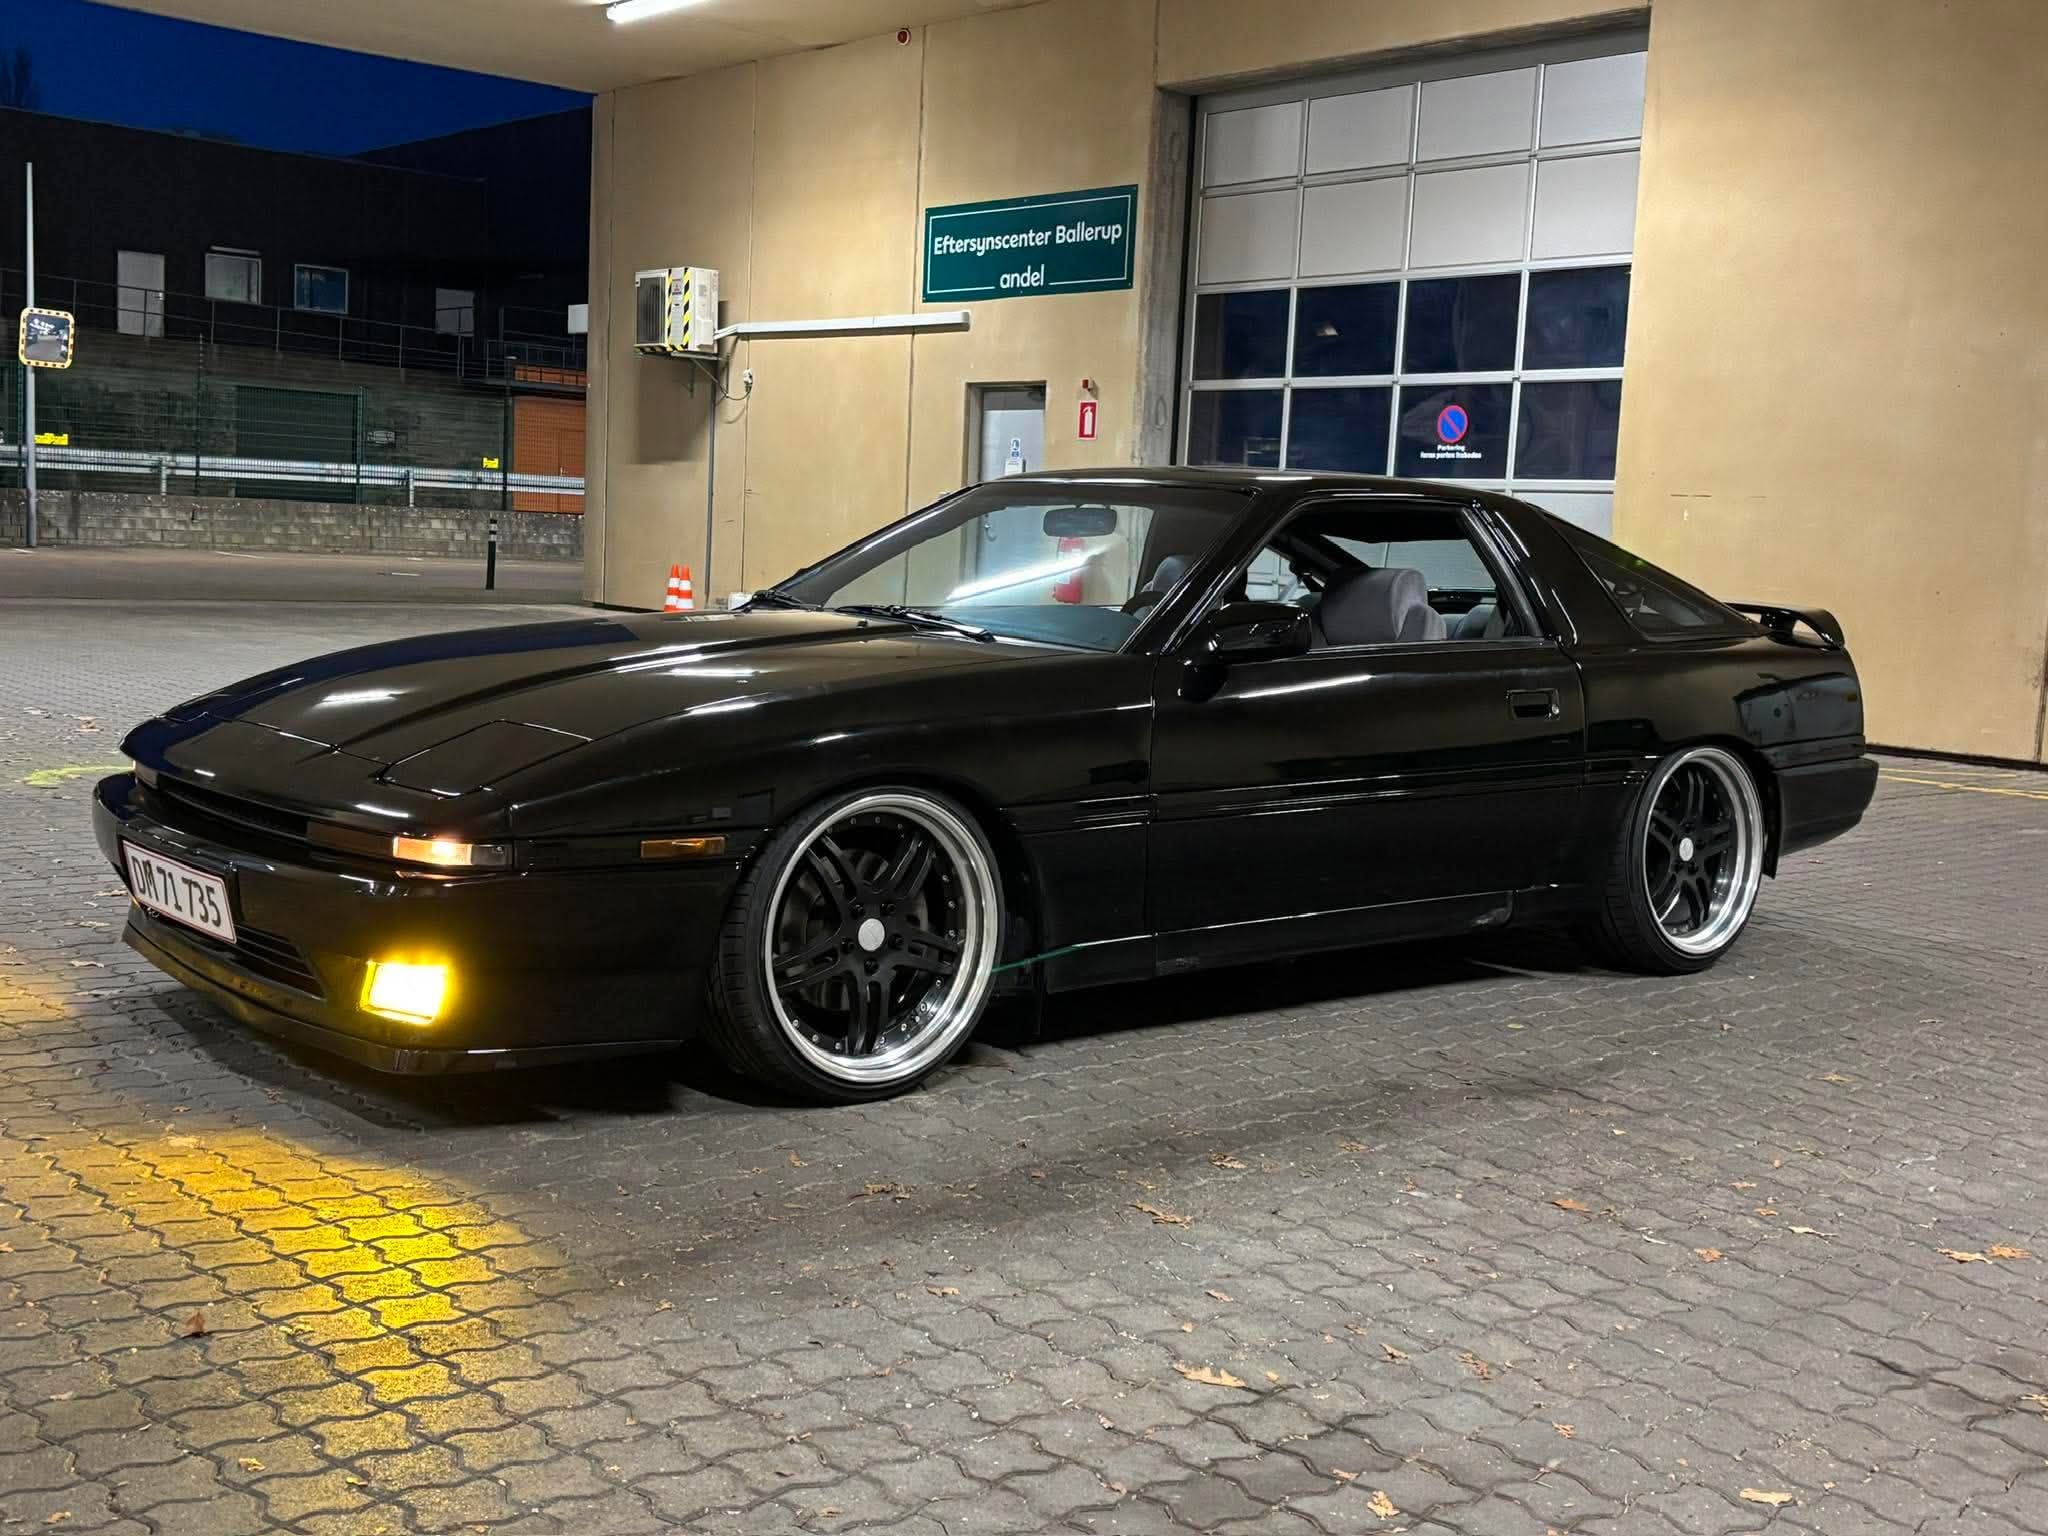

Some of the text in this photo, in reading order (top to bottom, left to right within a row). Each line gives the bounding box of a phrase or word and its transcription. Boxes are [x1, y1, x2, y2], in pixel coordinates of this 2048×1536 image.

[933, 221, 1122, 257] Eftersynscenter Ballerup
[1000, 263, 1045, 289] andel
[131, 855, 222, 928] DM 71 735
